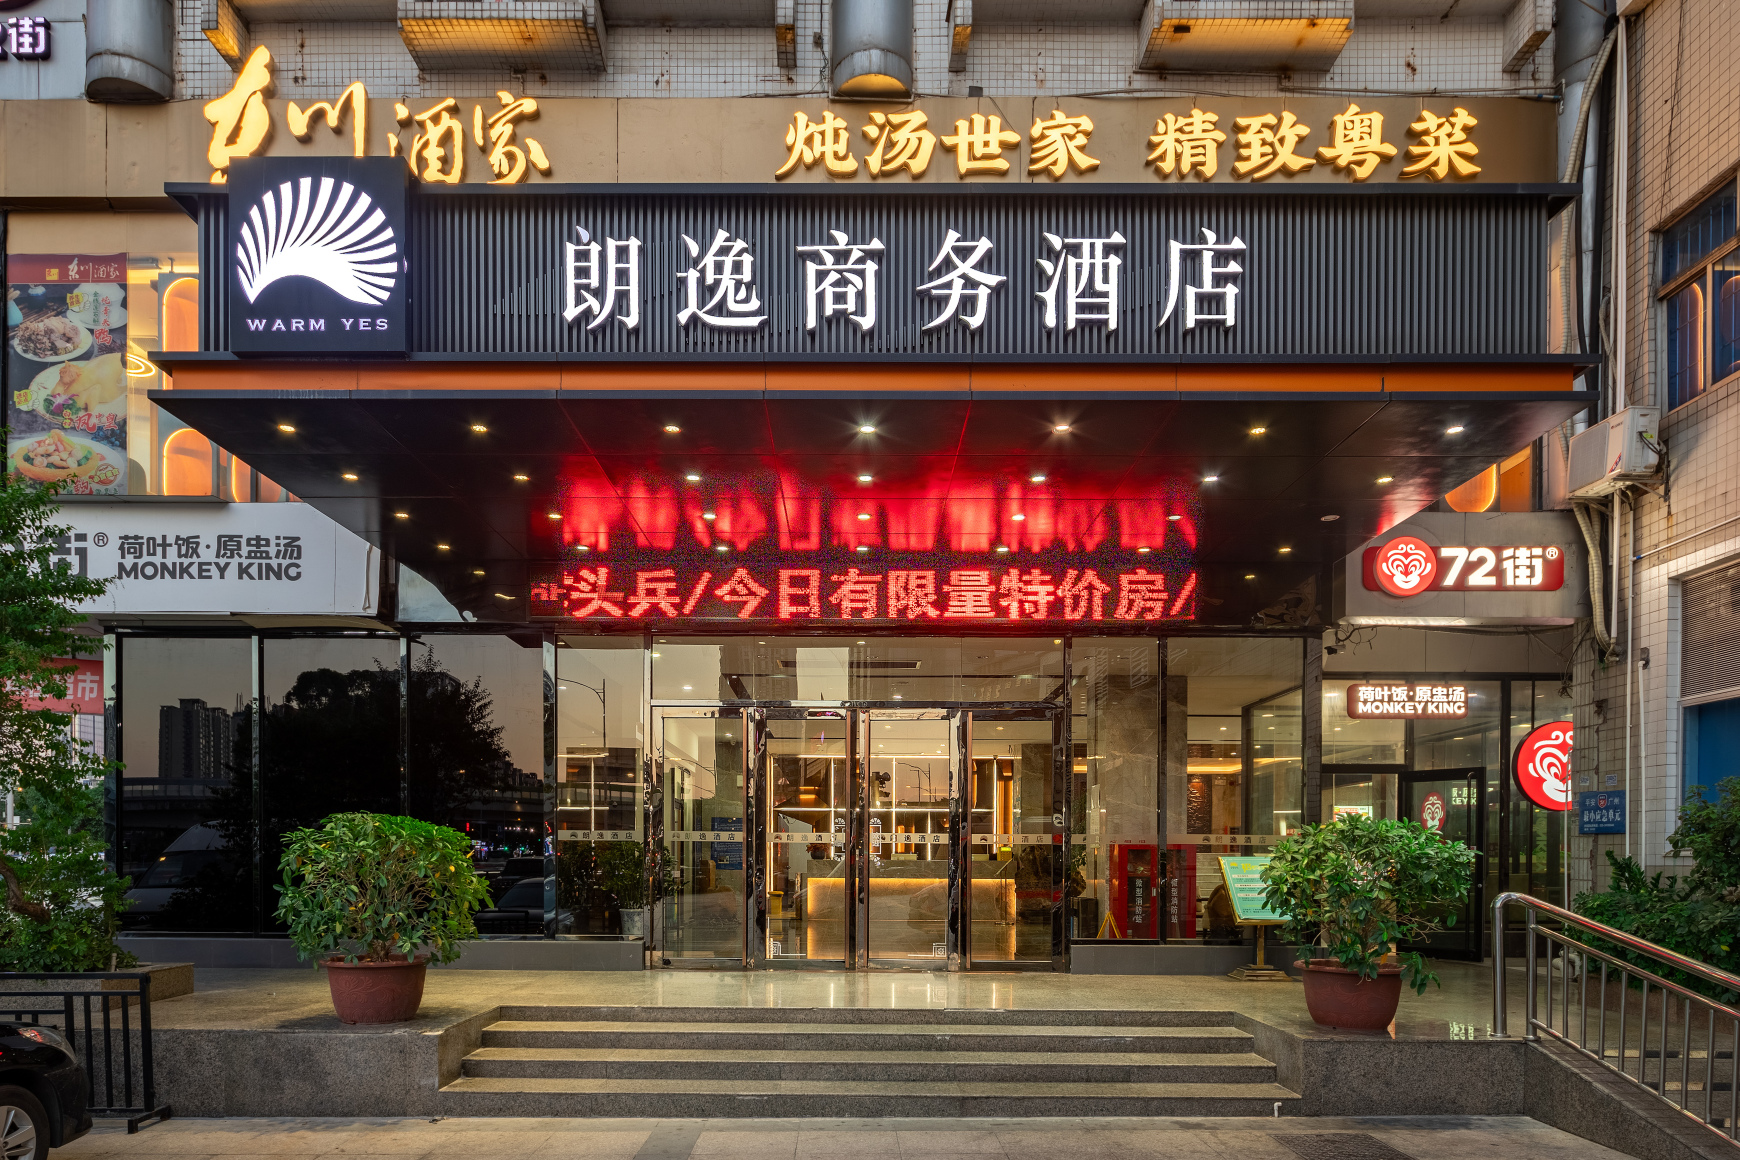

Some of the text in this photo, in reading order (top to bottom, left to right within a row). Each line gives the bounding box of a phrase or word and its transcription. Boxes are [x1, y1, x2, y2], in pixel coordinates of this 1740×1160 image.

[0, 16, 46, 54] 街
[775, 103, 1483, 183] 炖汤世家 精致粤菜
[562, 225, 1247, 334] 朗逸商务酒店
[246, 318, 389, 332] WARM YES
[117, 534, 303, 560] 荷叶饭·原盅汤
[117, 561, 303, 582] MONKEY KING
[1358, 686, 1466, 702] 荷叶饭·原盅汤
[1358, 701, 1466, 714] MONKEY KING
